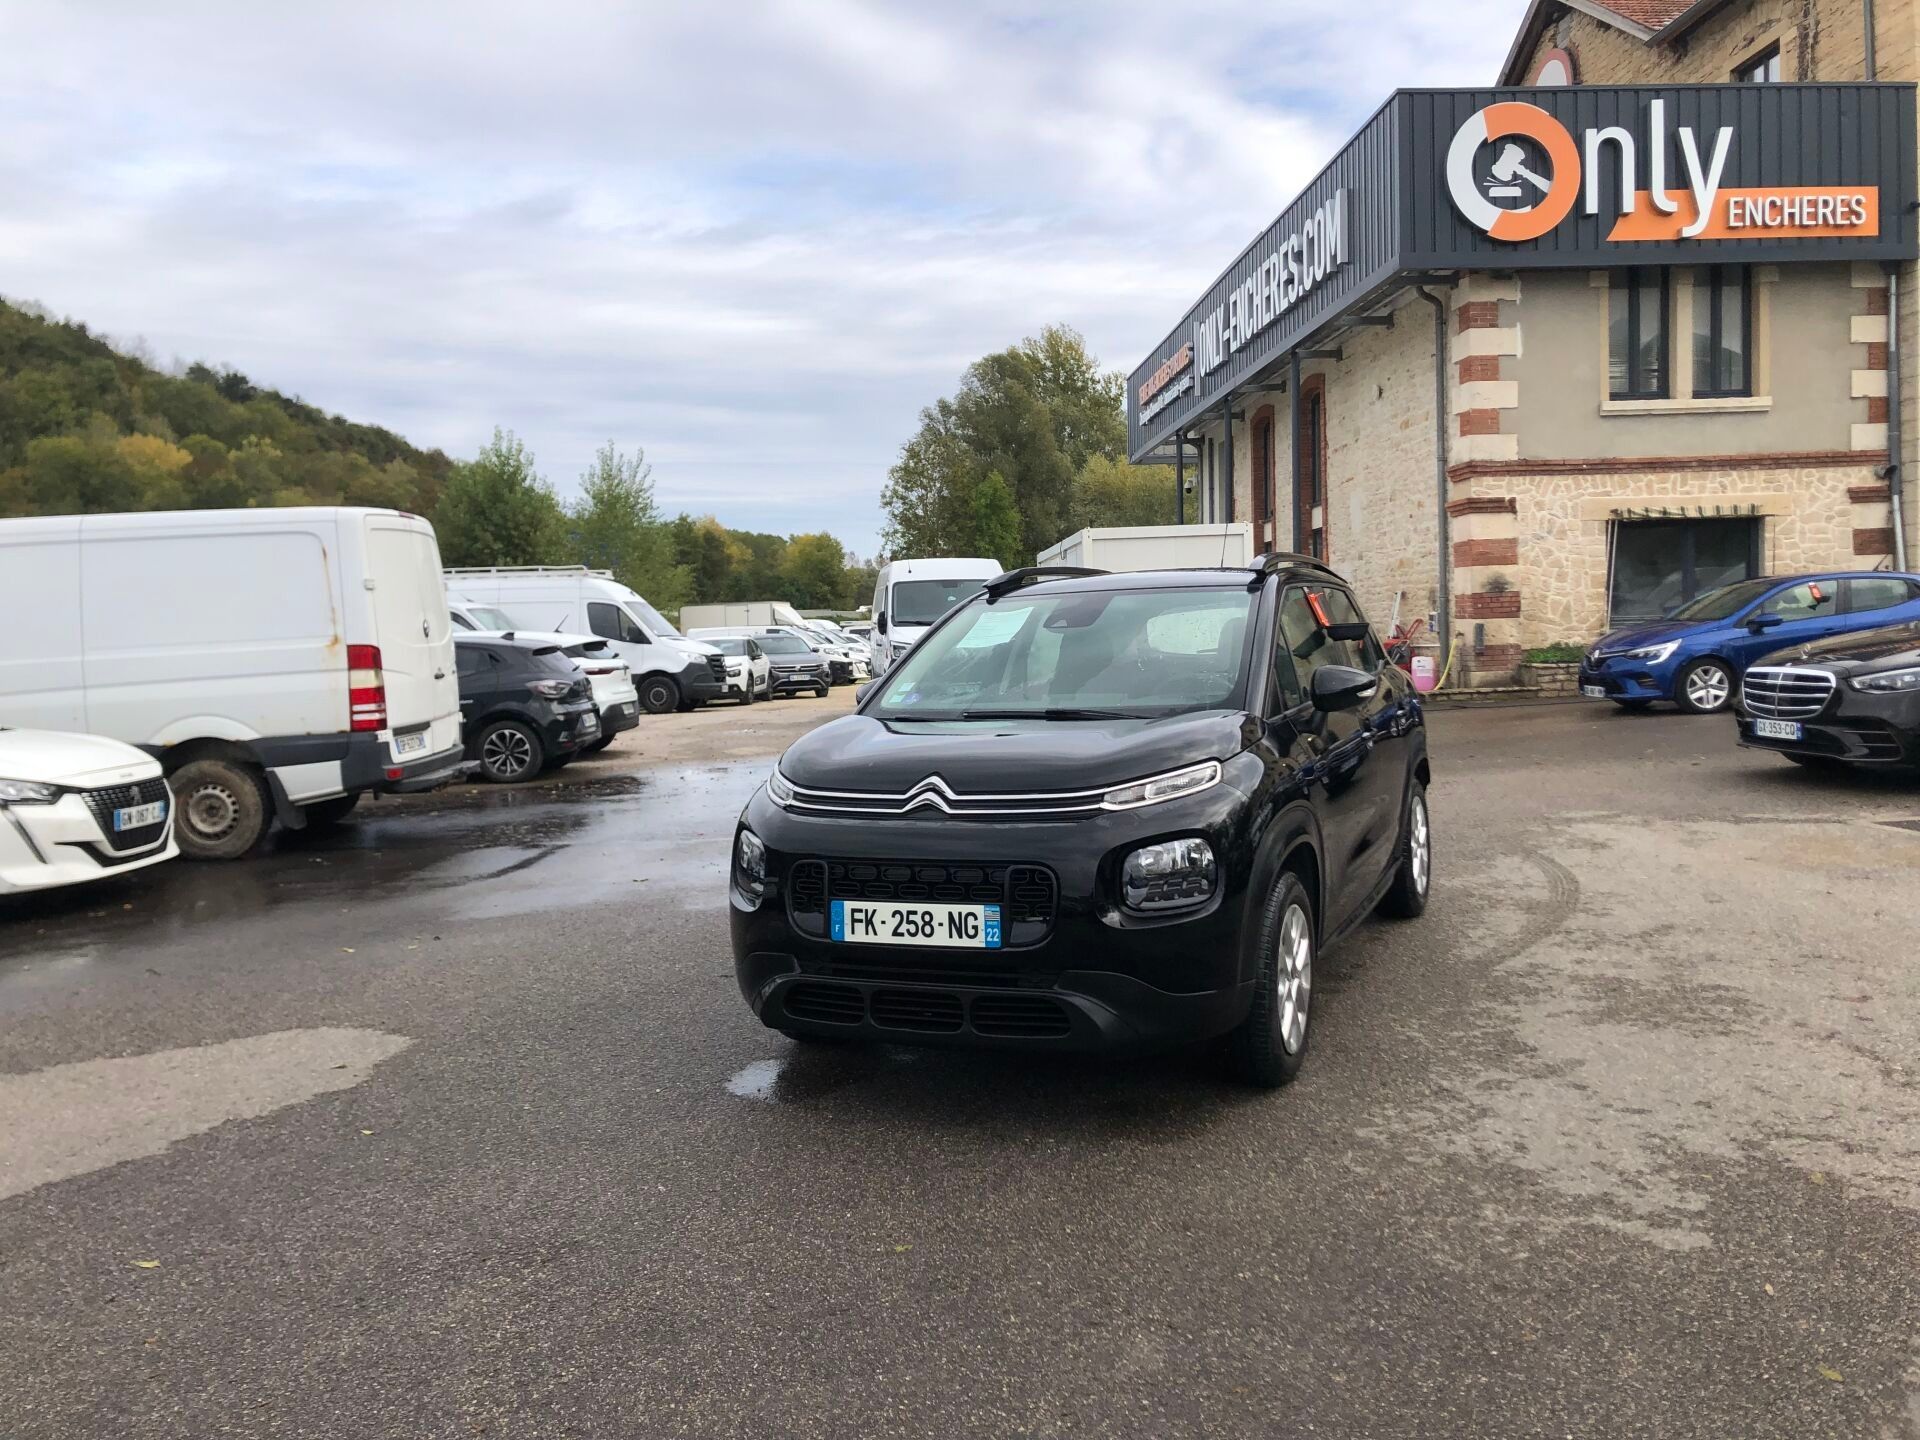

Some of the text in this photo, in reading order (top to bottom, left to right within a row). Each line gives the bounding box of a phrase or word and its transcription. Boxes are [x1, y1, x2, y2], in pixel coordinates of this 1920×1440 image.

[1446, 99, 1734, 241] Only
[1728, 194, 1868, 228] ENCHERES
[1199, 188, 1348, 378] ONLY-ENCHERES.COM
[850, 908, 979, 940] FK-258-NG
[986, 927, 1000, 942] 22
